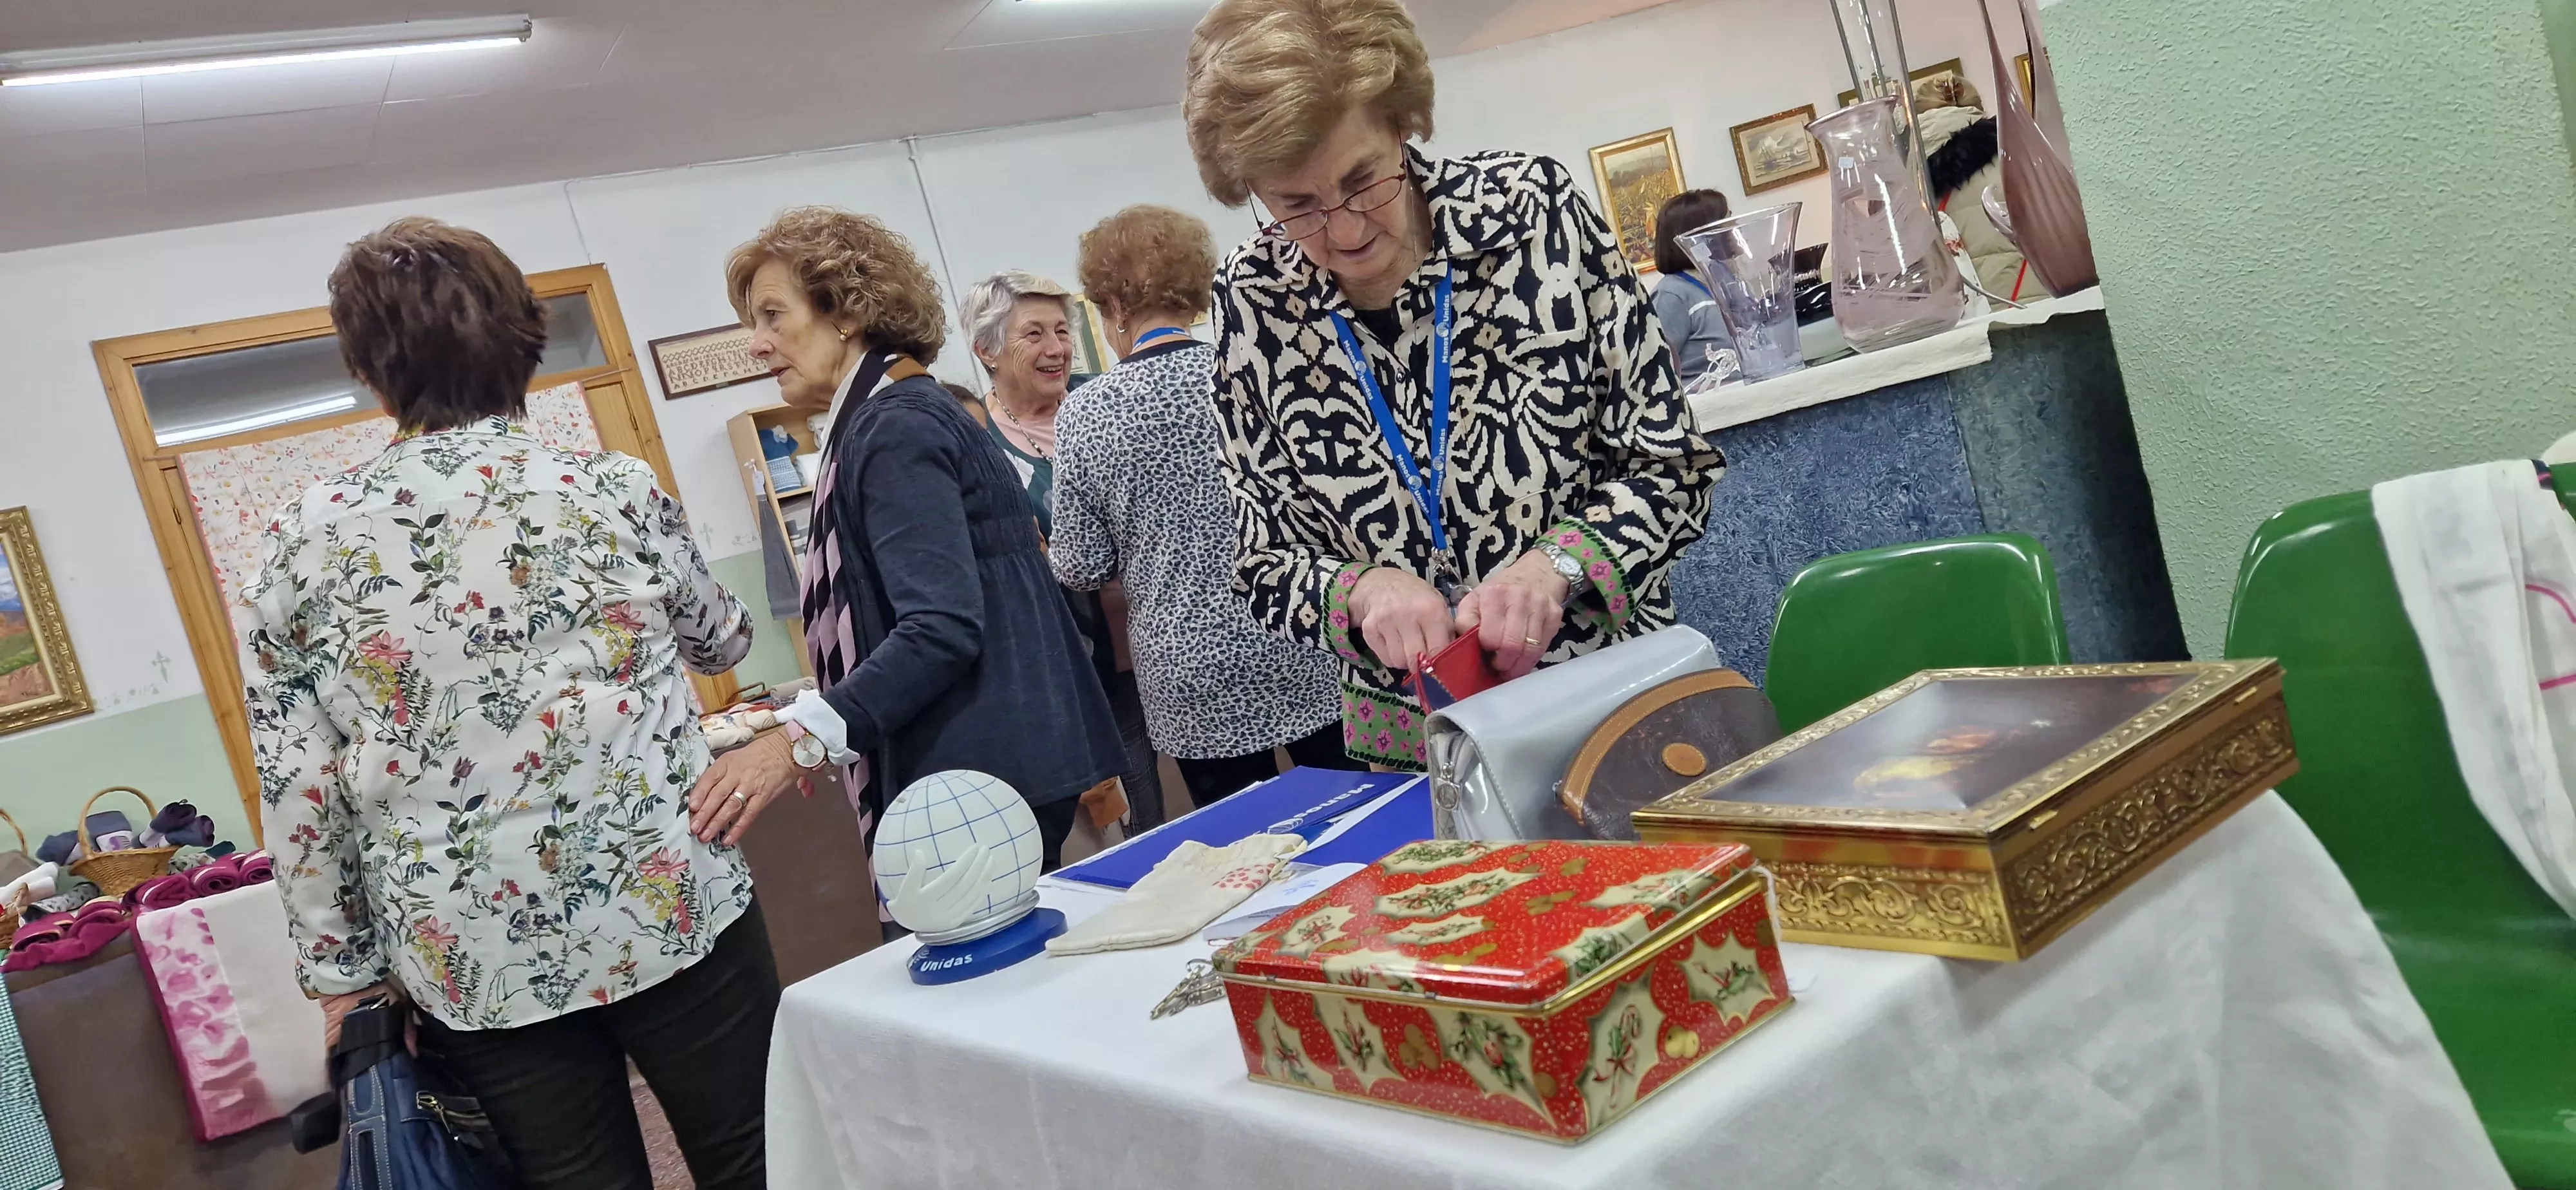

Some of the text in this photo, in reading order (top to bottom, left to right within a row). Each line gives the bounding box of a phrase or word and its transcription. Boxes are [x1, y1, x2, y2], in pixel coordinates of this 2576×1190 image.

[1343, 339, 1374, 401] Manos Unidas
[1396, 454, 1411, 478] Manos
[1294, 783, 1376, 818] Manos
[920, 954, 973, 972] Unidas
